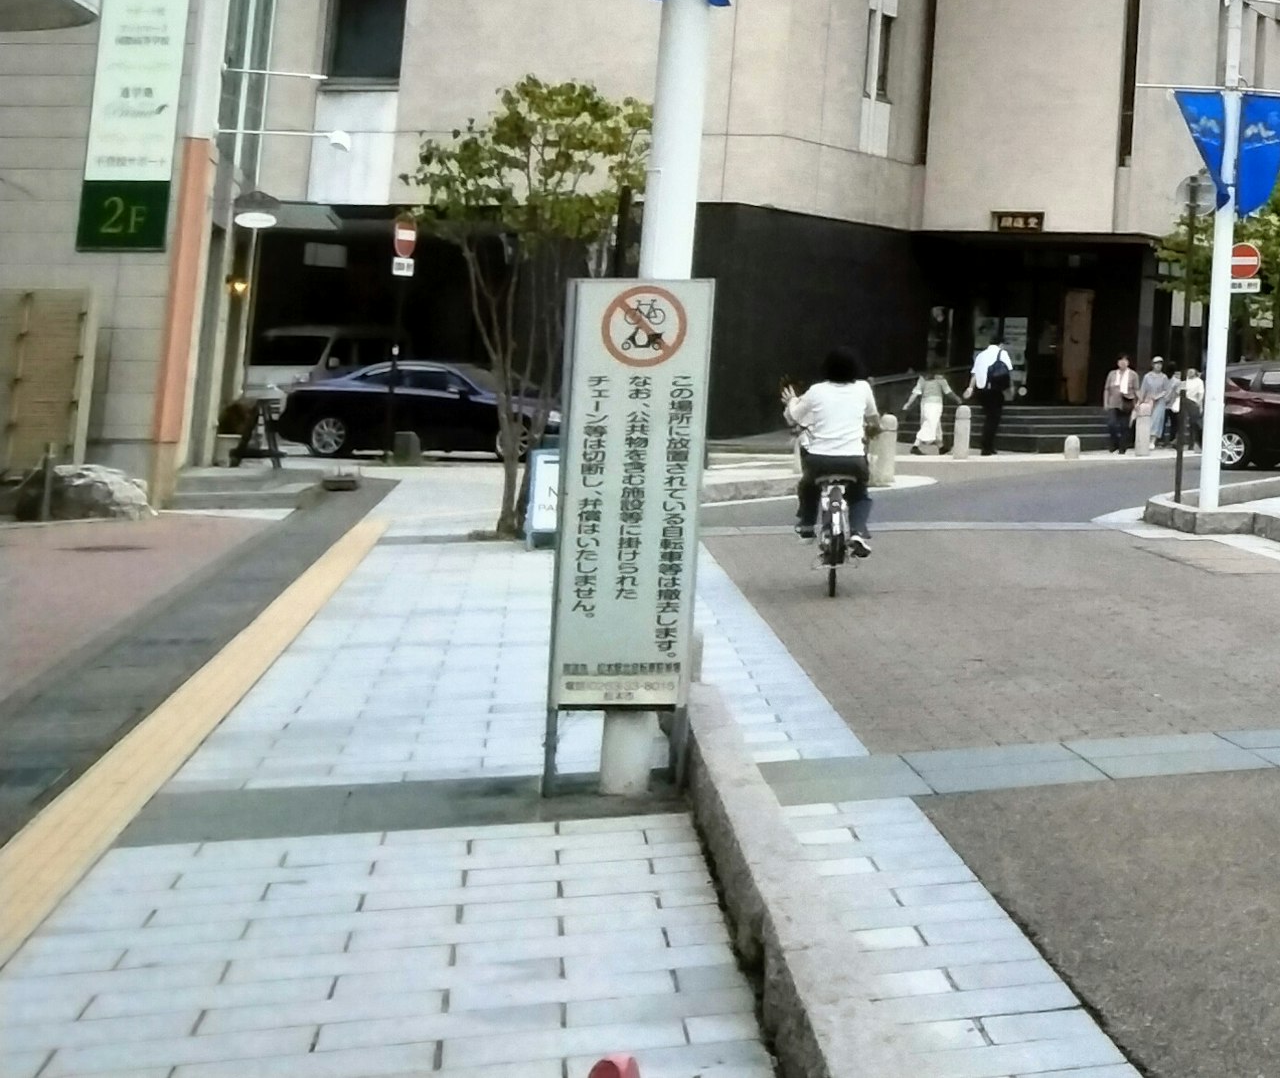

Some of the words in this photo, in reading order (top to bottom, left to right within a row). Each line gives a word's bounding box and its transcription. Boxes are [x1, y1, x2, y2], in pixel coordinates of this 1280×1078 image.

[571, 375, 610, 619] チェーン等は切断し、弁償はいたしません。
[615, 375, 652, 600] なお、公共物を含む施設等に掛けられた
[654, 375, 694, 659] この場所に放置されている自転車等は撤去します。
